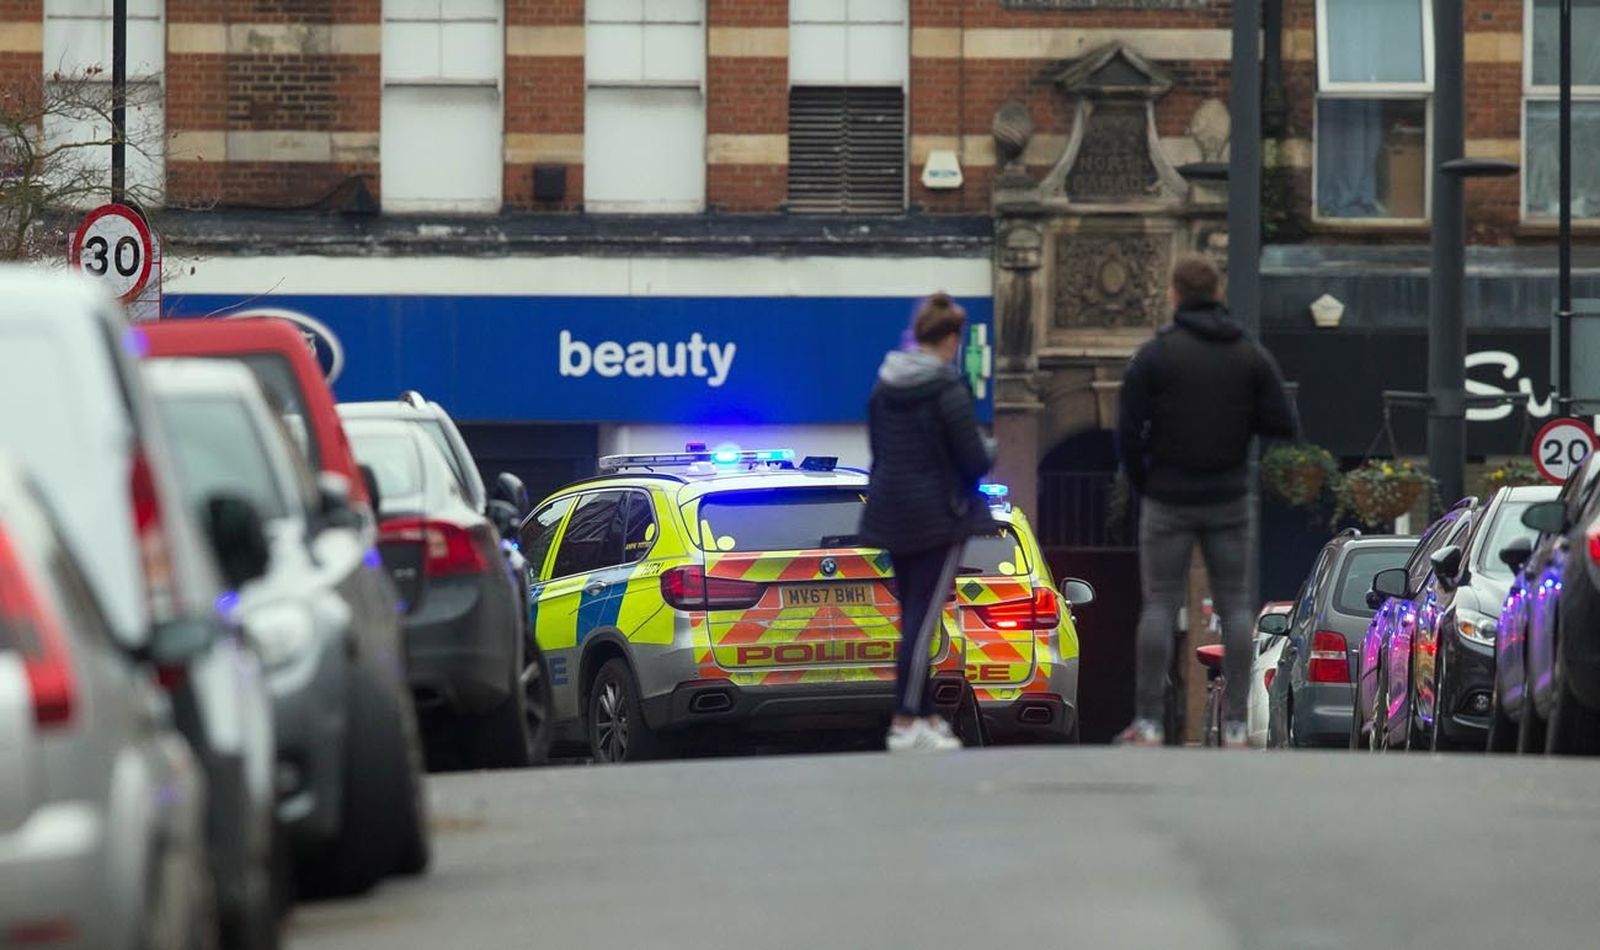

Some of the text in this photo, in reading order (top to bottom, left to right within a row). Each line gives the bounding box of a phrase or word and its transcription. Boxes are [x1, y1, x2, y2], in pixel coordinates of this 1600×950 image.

[85, 235, 140, 277] 30
[559, 330, 737, 387] beauty
[1544, 438, 1588, 465] 20
[788, 586, 866, 604] MV67 BWH
[737, 641, 897, 665] POLIC
